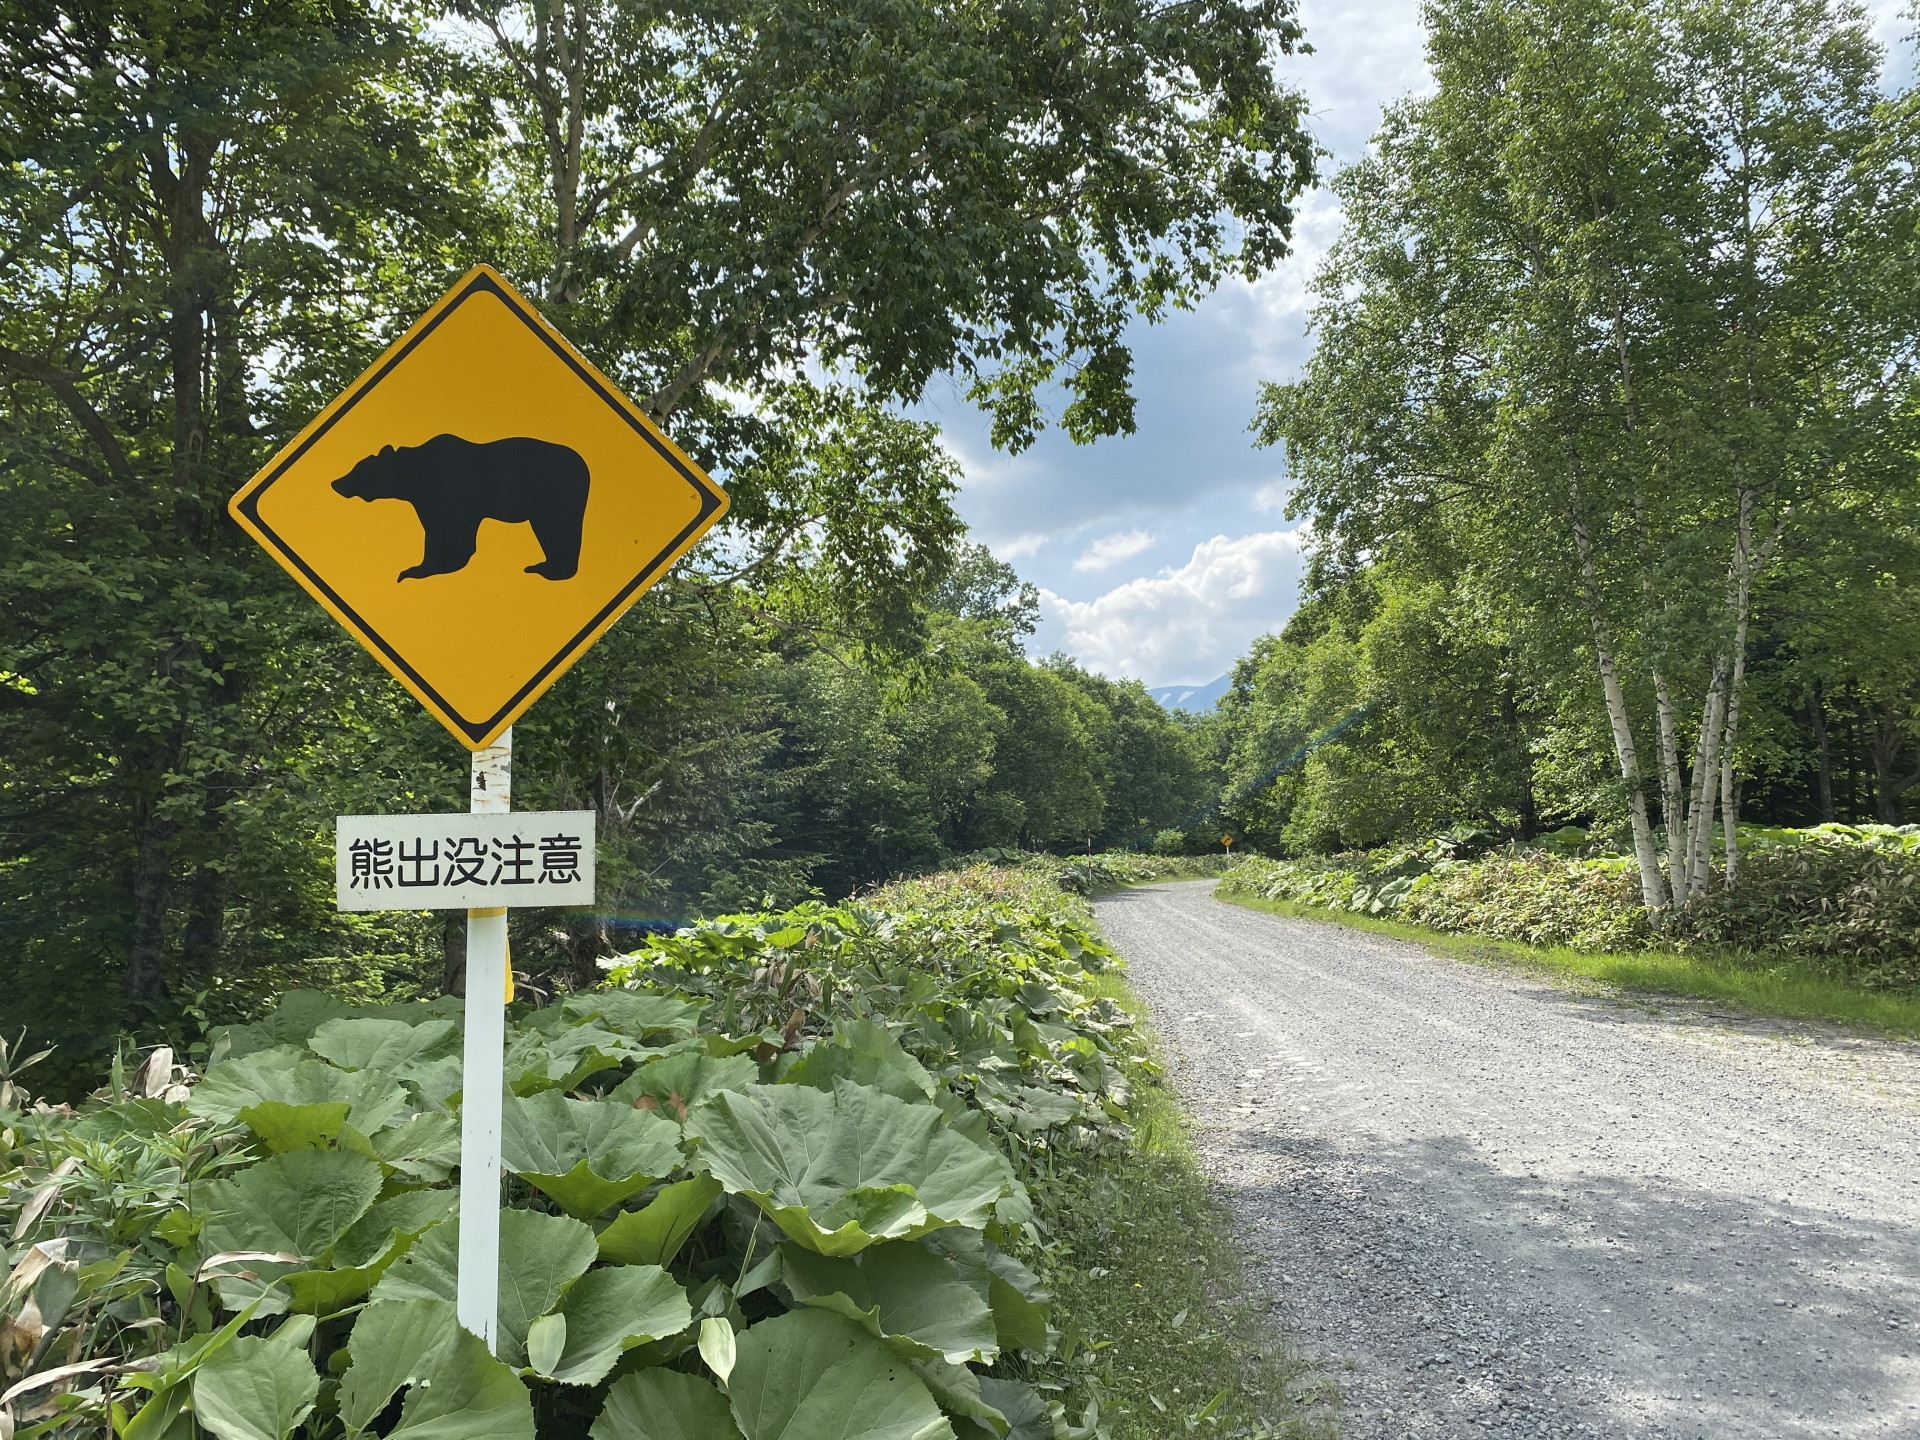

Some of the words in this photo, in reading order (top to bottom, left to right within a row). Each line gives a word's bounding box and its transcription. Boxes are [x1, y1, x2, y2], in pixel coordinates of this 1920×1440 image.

[349, 833, 582, 889] 熊出没注意
